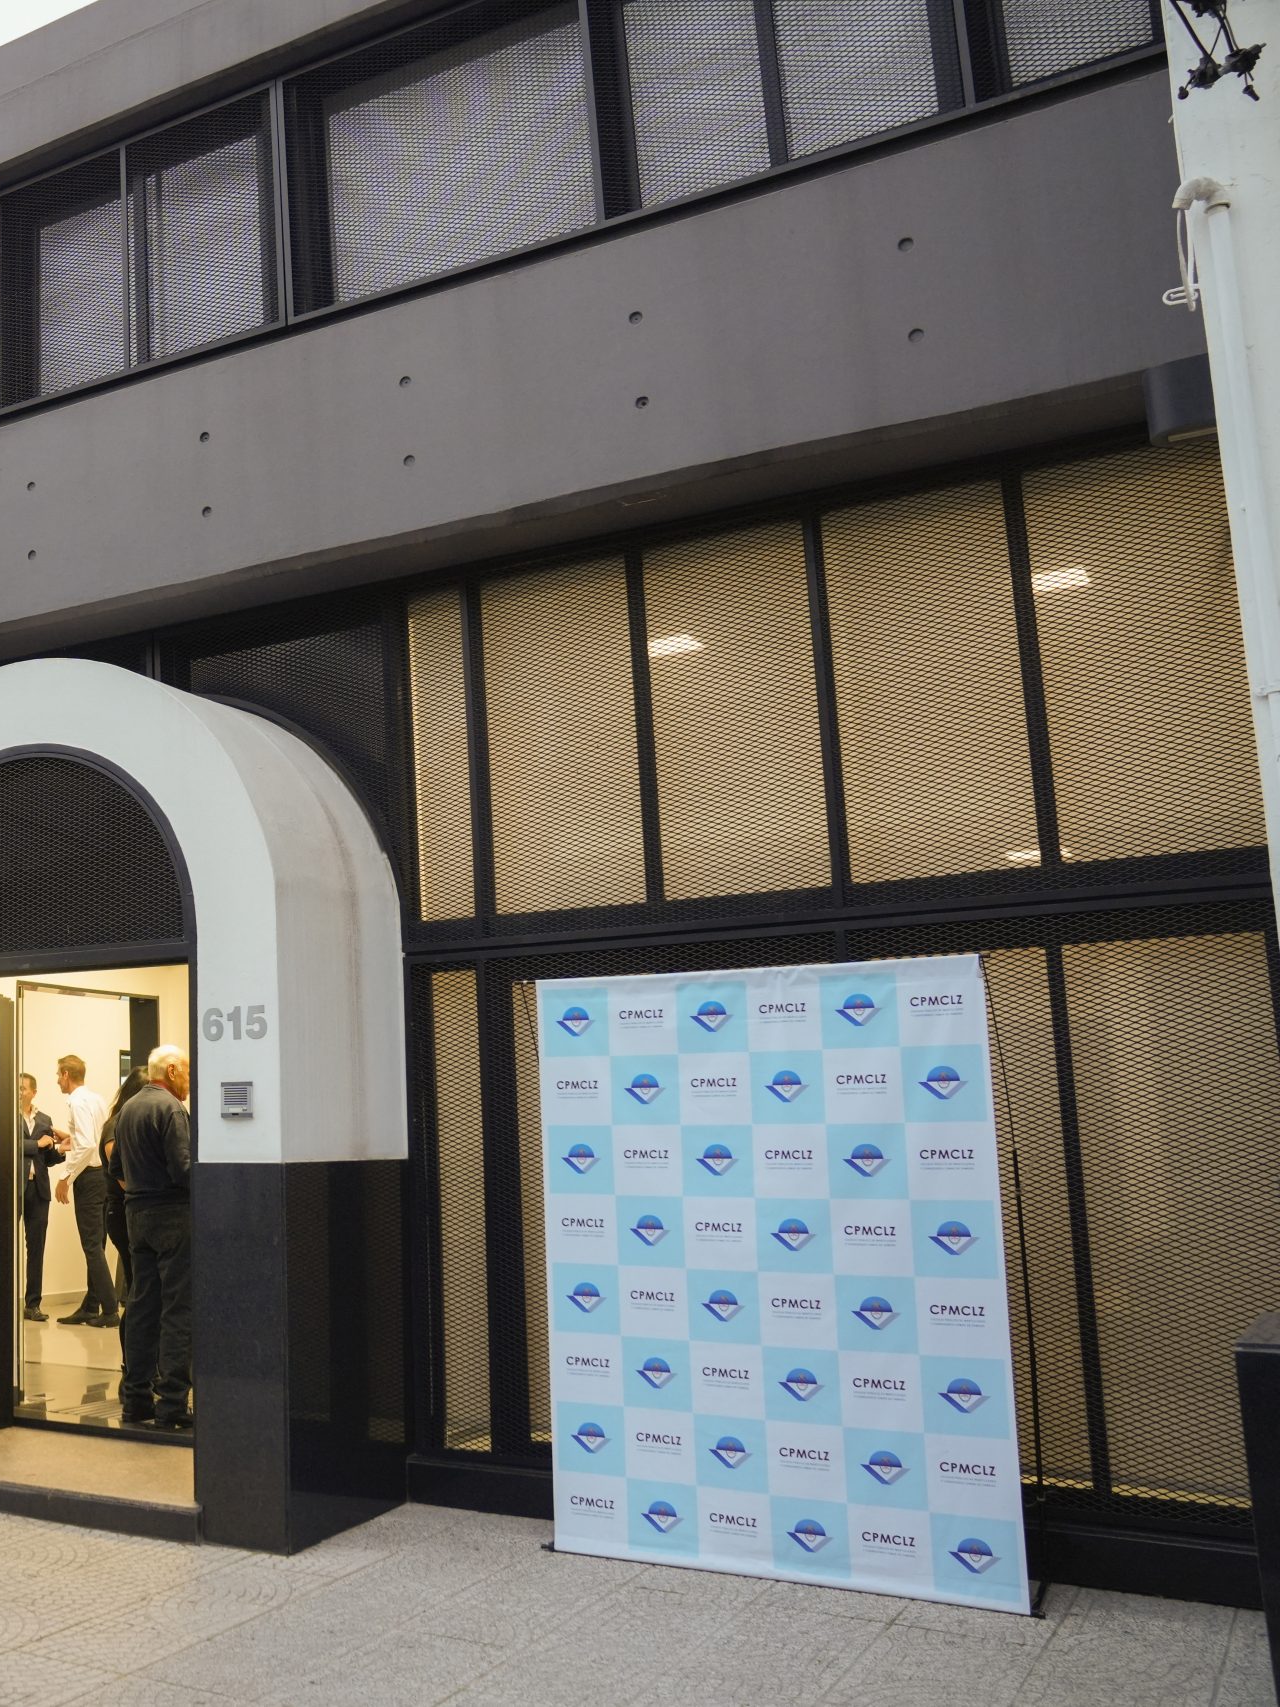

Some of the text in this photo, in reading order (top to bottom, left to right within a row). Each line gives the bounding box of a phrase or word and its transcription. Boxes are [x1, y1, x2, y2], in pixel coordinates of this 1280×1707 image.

[909, 994, 963, 1007] CPMCLZ
[758, 1002, 806, 1014] CPMCLZ
[618, 1009, 664, 1020] CPMCLZ
[202, 1004, 268, 1042] 615
[556, 1080, 598, 1090] CPMCLZ
[690, 1077, 737, 1088] CPMCLZ
[836, 1073, 887, 1085] CPMCLZ
[623, 1149, 669, 1159] CPMCLZ
[764, 1149, 813, 1160] CPMCLZ
[919, 1149, 974, 1160] CPMCLZ
[561, 1217, 605, 1228] CPMCLZ
[695, 1221, 742, 1233] CPMCLZ
[844, 1225, 896, 1237] CPMCLZ
[630, 1290, 675, 1302] CPMCLZ
[771, 1297, 821, 1310] CPMCLZ
[929, 1304, 985, 1317] CPMCLZ
[566, 1356, 610, 1368] CPMCLZ
[702, 1366, 750, 1380] CPMCLZ
[852, 1377, 906, 1391] CPMCLZ
[636, 1432, 681, 1446] CPMCLZ
[779, 1447, 830, 1461] CPMCLZ
[939, 1461, 996, 1477] CPMCLZ
[570, 1495, 615, 1510] CPMCLZ
[709, 1512, 757, 1528] CPMCLZ
[861, 1531, 916, 1548] CPMCLZ
